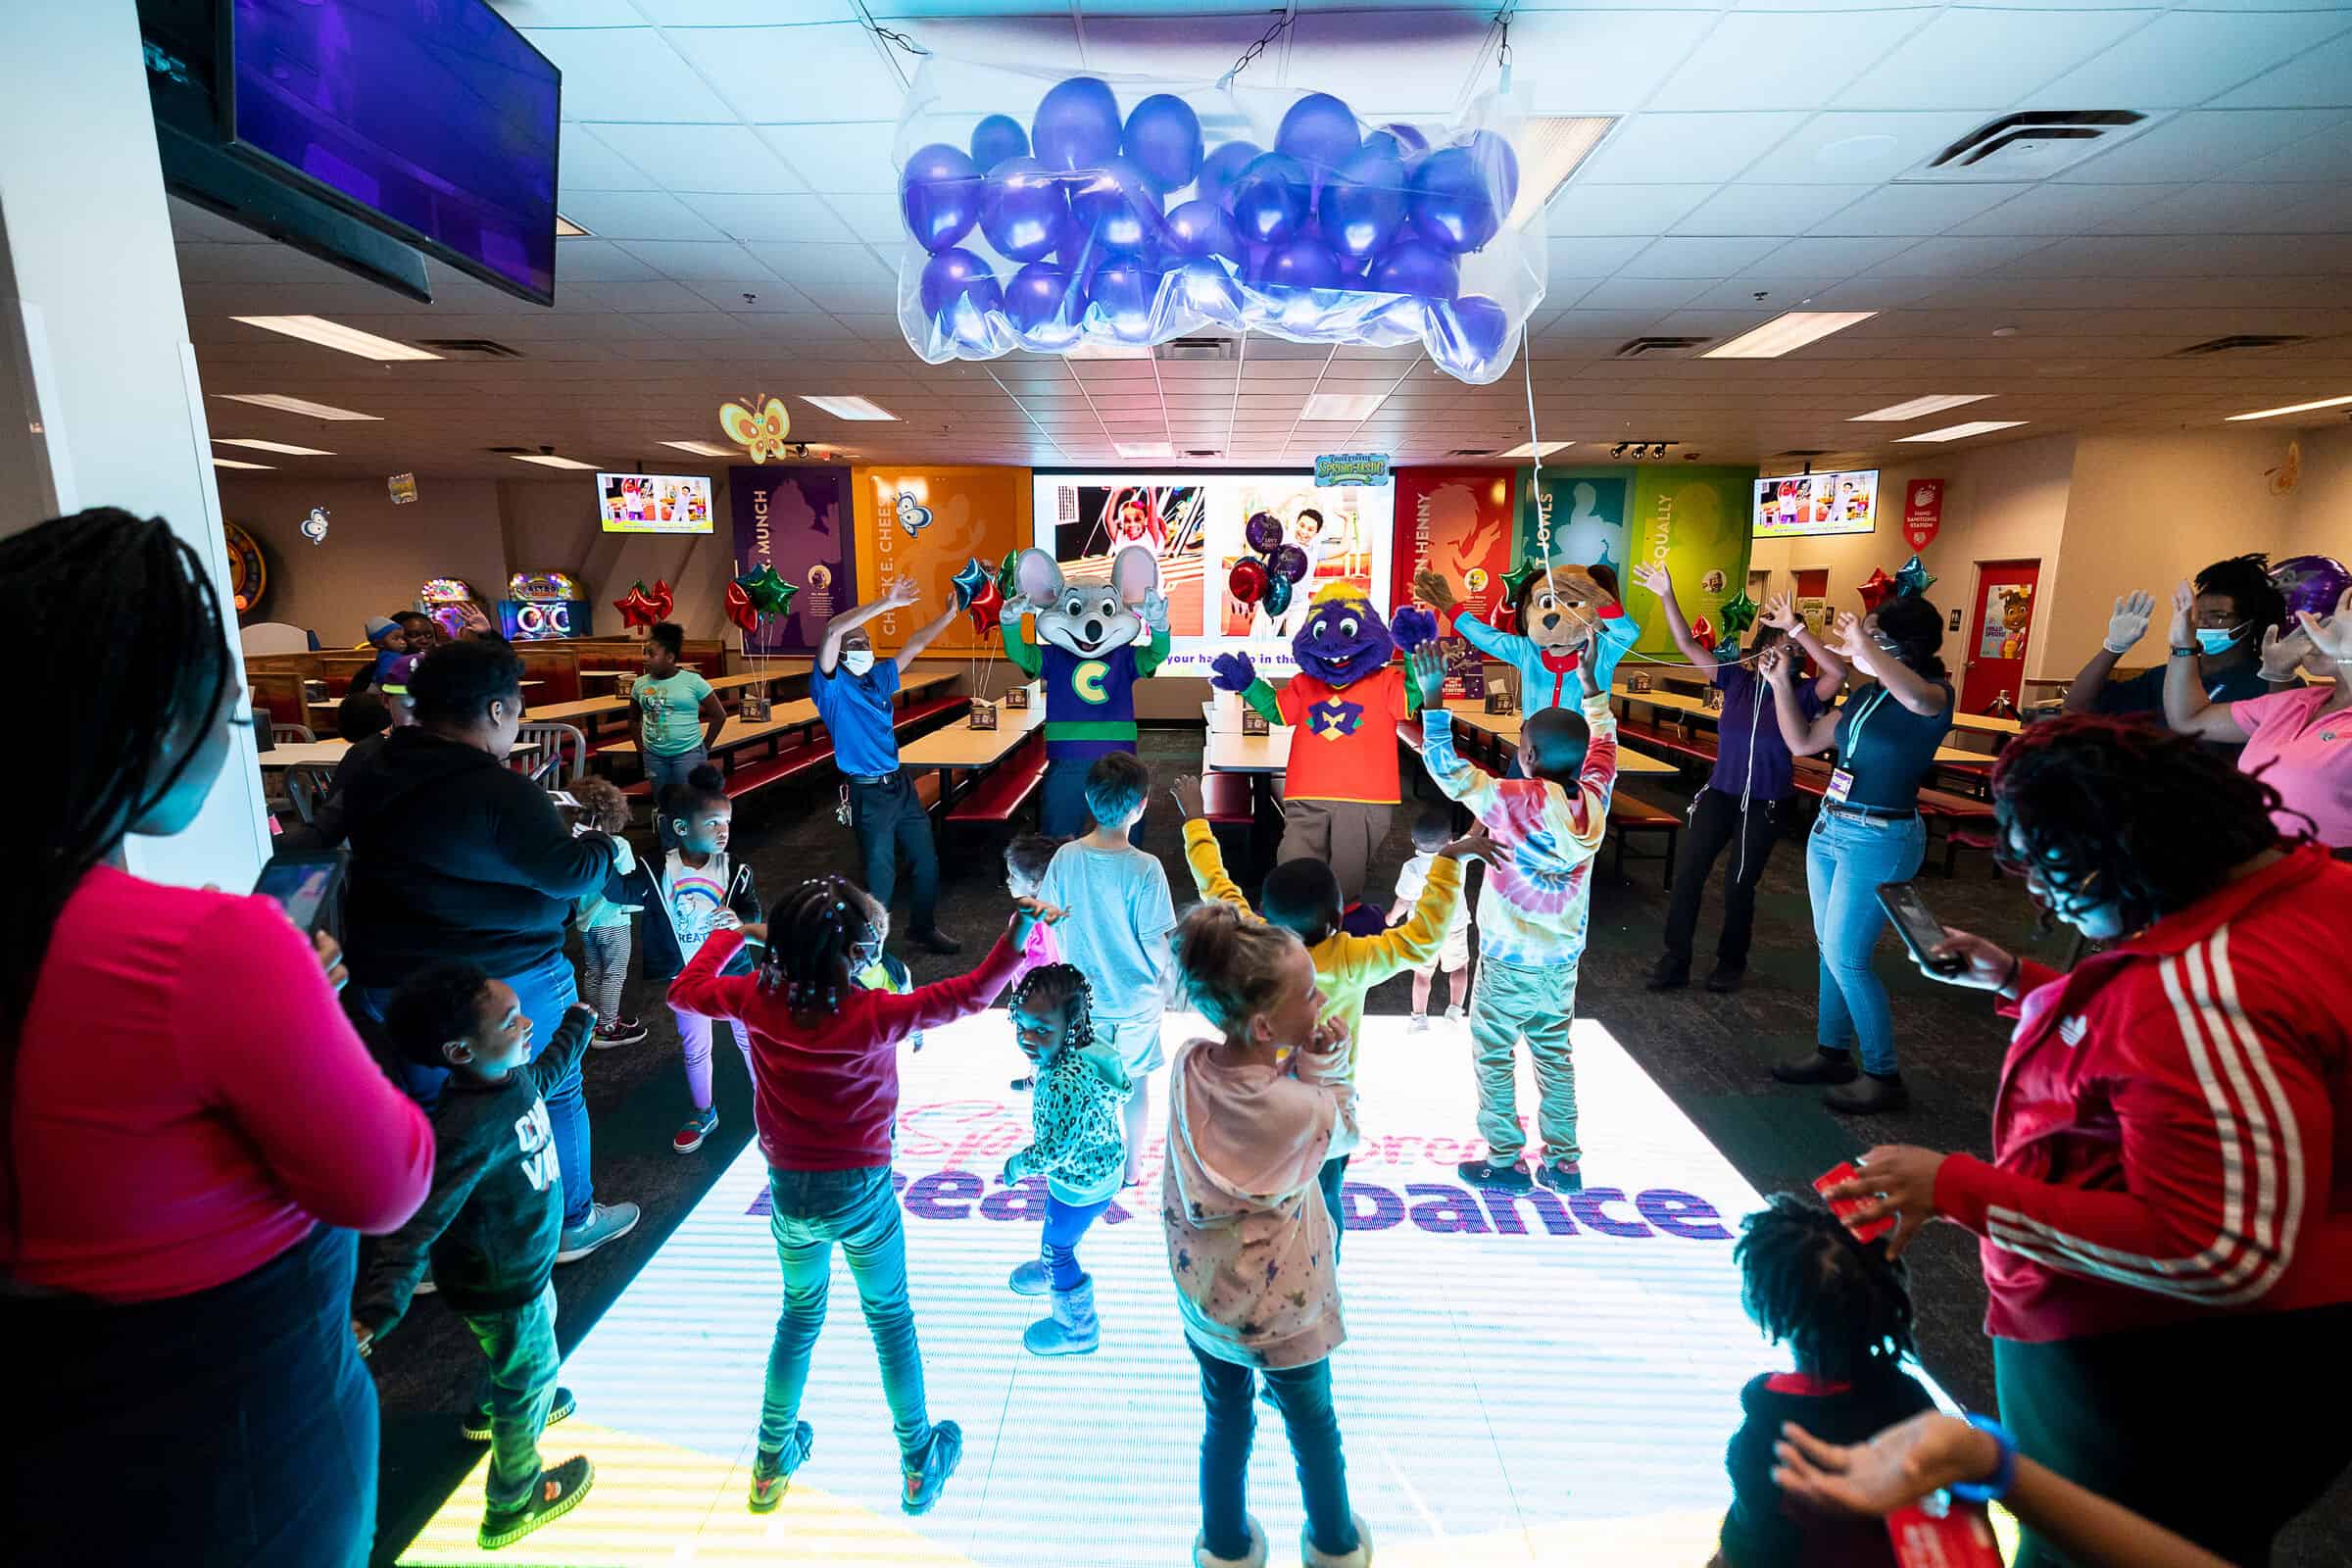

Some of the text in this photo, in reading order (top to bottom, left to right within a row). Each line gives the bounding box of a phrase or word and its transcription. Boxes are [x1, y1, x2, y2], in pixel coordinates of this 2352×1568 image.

[754, 490, 770, 555] MUNCH
[1414, 493, 1432, 554] HENNY
[1071, 660, 1110, 705] C
[1167, 655, 1195, 665] your
[1260, 653, 1271, 663] in
[1342, 1181, 1736, 1240] Dance
